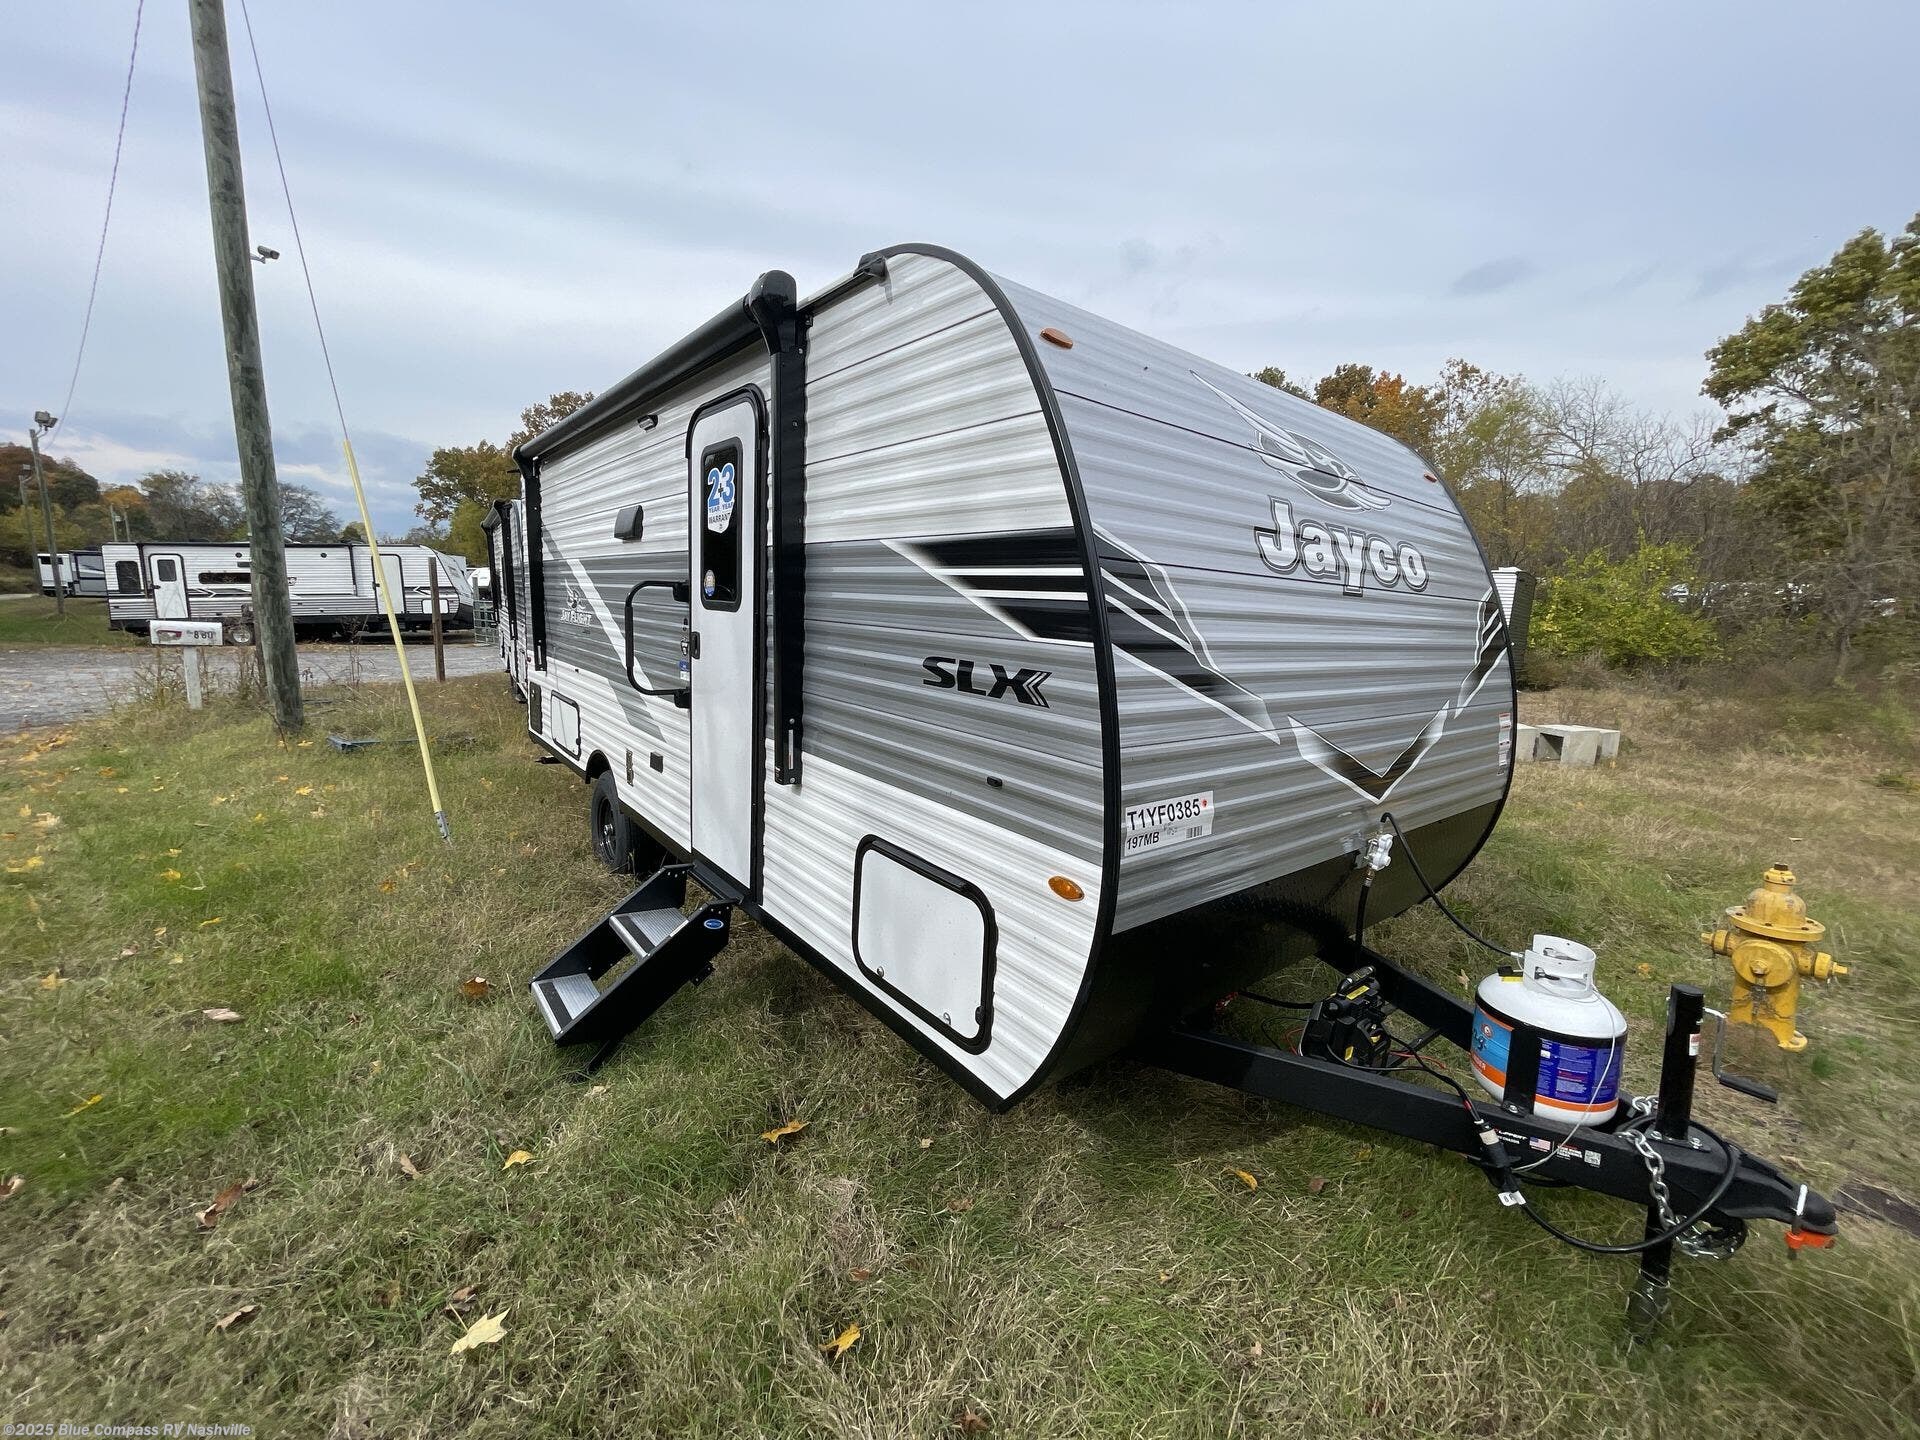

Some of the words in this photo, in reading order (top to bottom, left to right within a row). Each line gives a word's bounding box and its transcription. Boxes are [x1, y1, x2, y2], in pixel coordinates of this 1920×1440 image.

[709, 512, 731, 524] WARRANT
[1254, 495, 1429, 597] Jayco
[923, 656, 1052, 708] SLX
[1127, 798, 1201, 831] T1YF0385
[1127, 831, 1160, 850] 197MB
